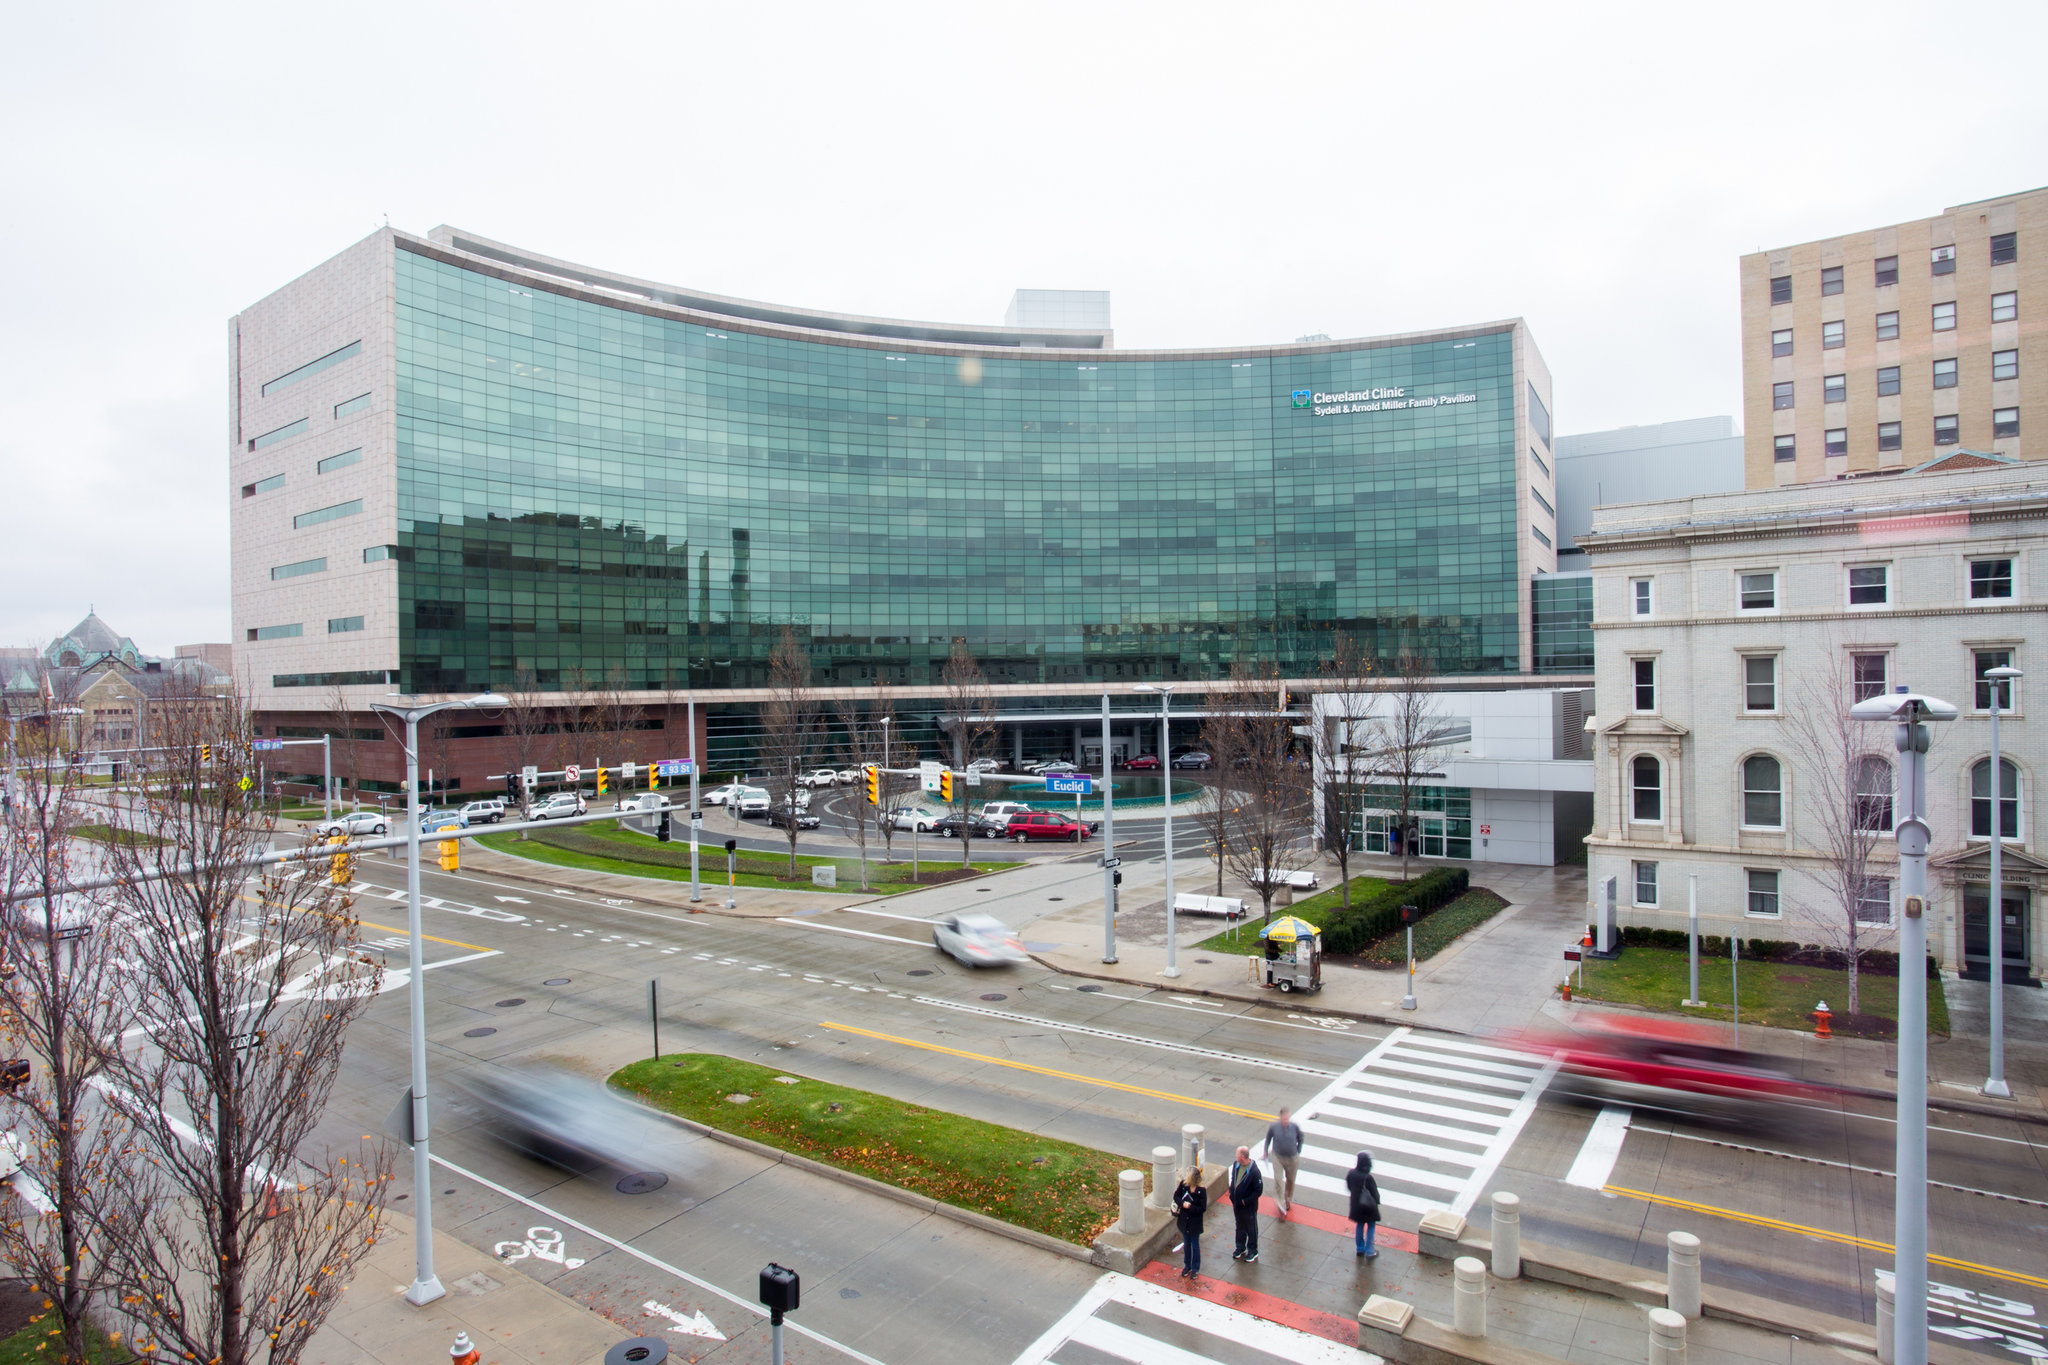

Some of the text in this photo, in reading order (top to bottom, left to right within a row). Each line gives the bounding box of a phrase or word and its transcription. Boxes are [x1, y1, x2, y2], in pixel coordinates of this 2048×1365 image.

[1313, 386, 1405, 404] Cleveland Clinic
[1314, 393, 1476, 417] Sydell & Arnold Miller Family Pavilion
[659, 764, 690, 775] E. 93 St
[1053, 780, 1084, 792] Euclid
[1962, 872, 2031, 883] CLINIC ILDING
